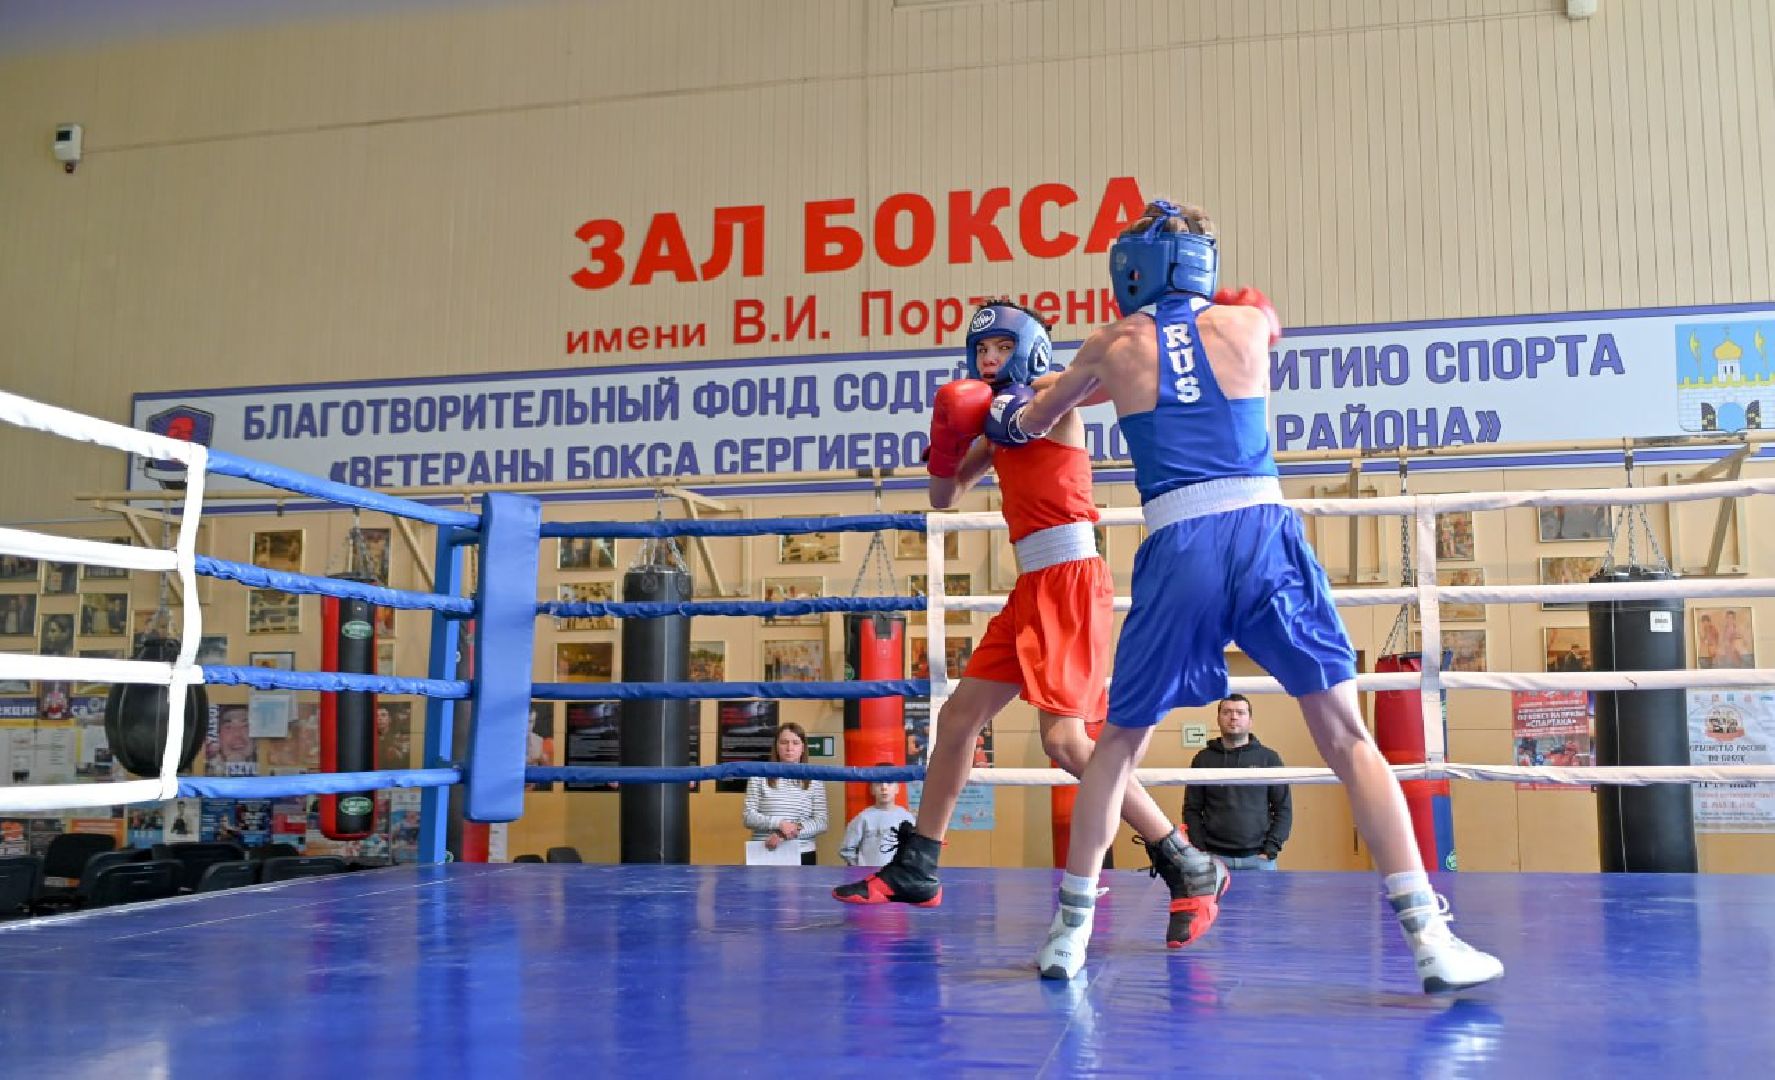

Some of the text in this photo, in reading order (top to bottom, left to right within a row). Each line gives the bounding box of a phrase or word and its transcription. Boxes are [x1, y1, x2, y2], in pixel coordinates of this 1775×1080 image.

[570, 176, 1147, 289] ЗАЛ БОКСА
[566, 320, 706, 355] имени
[733, 295, 831, 344] В.И.
[1163, 323, 1201, 404] RUS
[243, 376, 680, 441] БЛАГОТВОРИТЕЛЬНЫЙ
[692, 376, 821, 420] ФОНД
[1269, 344, 1410, 391] ИТИЮ
[1425, 332, 1626, 384] СПОРТА
[329, 447, 555, 488] «ВЕТЕРАНЫ
[566, 441, 701, 480] БОКСА
[1276, 403, 1502, 451] РАЙОНА»
